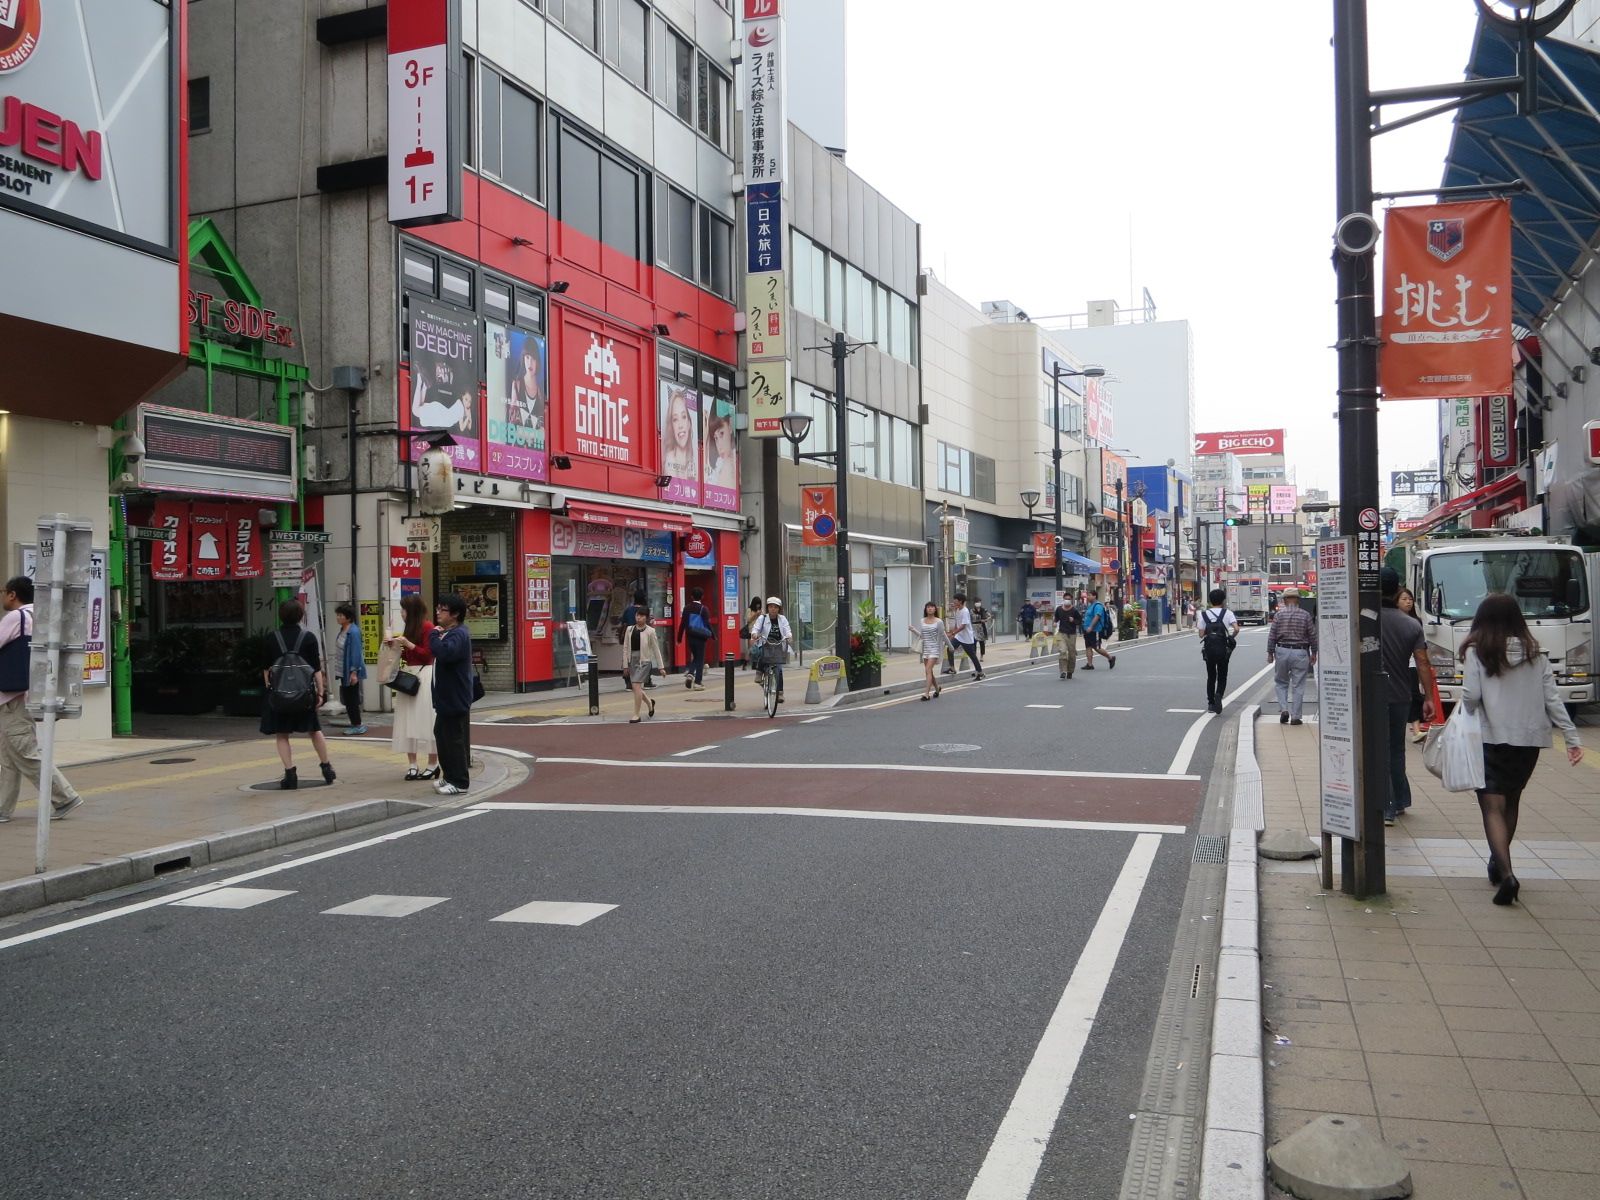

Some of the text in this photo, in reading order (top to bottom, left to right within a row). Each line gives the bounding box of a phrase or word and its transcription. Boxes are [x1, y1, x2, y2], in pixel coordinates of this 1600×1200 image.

[404, 59, 434, 89] 3F
[766, 51, 775, 91] 弁護士法人
[769, 158, 776, 177] 5F
[404, 175, 434, 204] 1F
[758, 208, 771, 267] 日本旅行
[767, 276, 778, 310] うまい
[1394, 273, 1498, 327] 挑む
[224, 299, 278, 344] SIDE
[415, 318, 435, 334] NEW
[435, 325, 472, 345] MACHINE
[751, 306, 762, 340] うまい
[415, 330, 473, 363] DEBUT!
[751, 371, 783, 405] うまか
[574, 385, 629, 443] GAME
[1492, 396, 1507, 459] OTTERIA
[576, 437, 629, 461] TAITO STATION
[1218, 436, 1275, 450] BIG ECHO
[506, 455, 537, 473] コスプレ
[236, 519, 252, 565] カラオケ
[274, 532, 320, 542] WEST SIDE
[553, 522, 573, 549] 2F
[624, 528, 641, 553] 3F
[688, 541, 705, 550] GAME
[1358, 532, 1369, 570] 禁止区域
